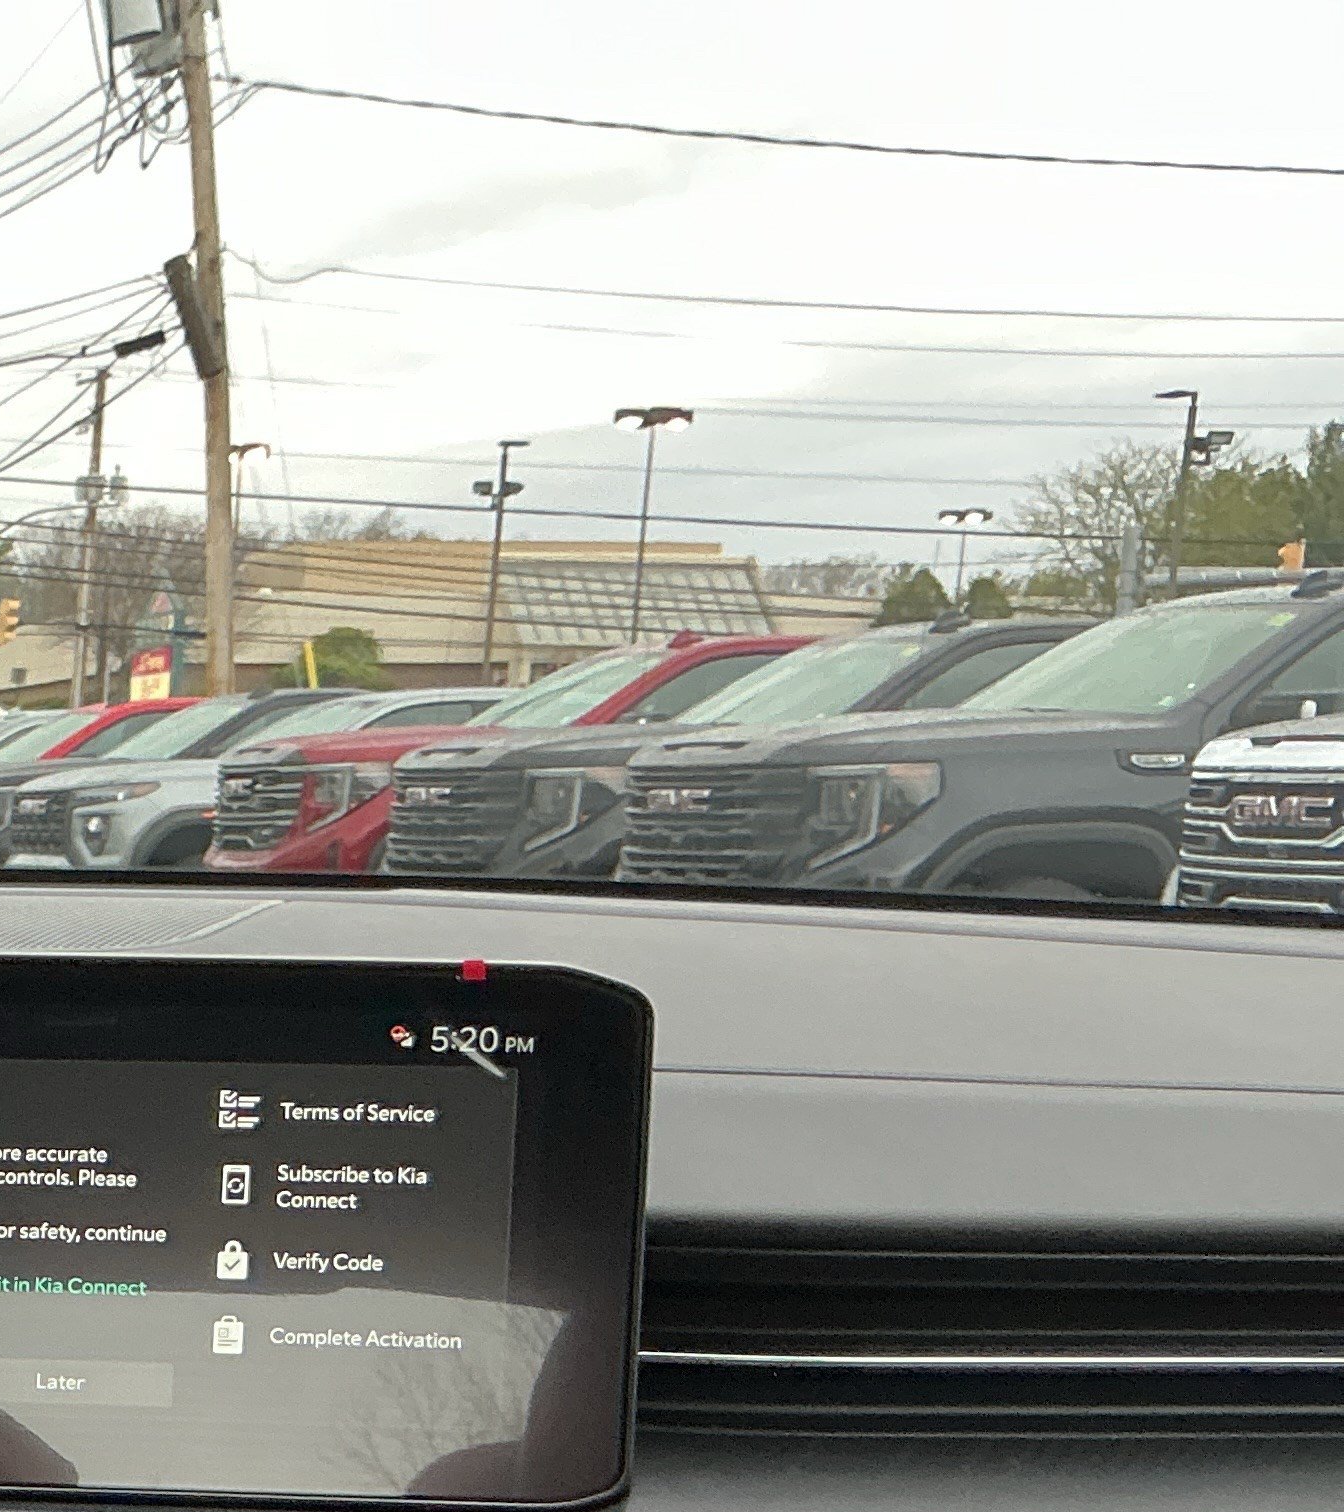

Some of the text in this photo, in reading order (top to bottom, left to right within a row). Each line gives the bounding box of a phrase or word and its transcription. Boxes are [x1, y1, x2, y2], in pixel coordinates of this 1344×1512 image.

[1233, 795, 1334, 827] GMC
[430, 1025, 535, 1053] 5:20 PM
[280, 1102, 436, 1124] Terms of Service
[26, 1147, 108, 1163] accurate
[78, 1170, 137, 1188] Please
[277, 1164, 428, 1186] Subscribe to Kia
[275, 1190, 358, 1211] Connect
[20, 1223, 80, 1243] safety,
[85, 1225, 166, 1243] continue
[273, 1252, 384, 1274] Verify Code
[14, 1277, 31, 1293] in
[35, 1277, 63, 1294] Kia
[68, 1278, 146, 1297] Connect
[269, 1327, 463, 1350] Complete Activation
[35, 1372, 86, 1392] Later
